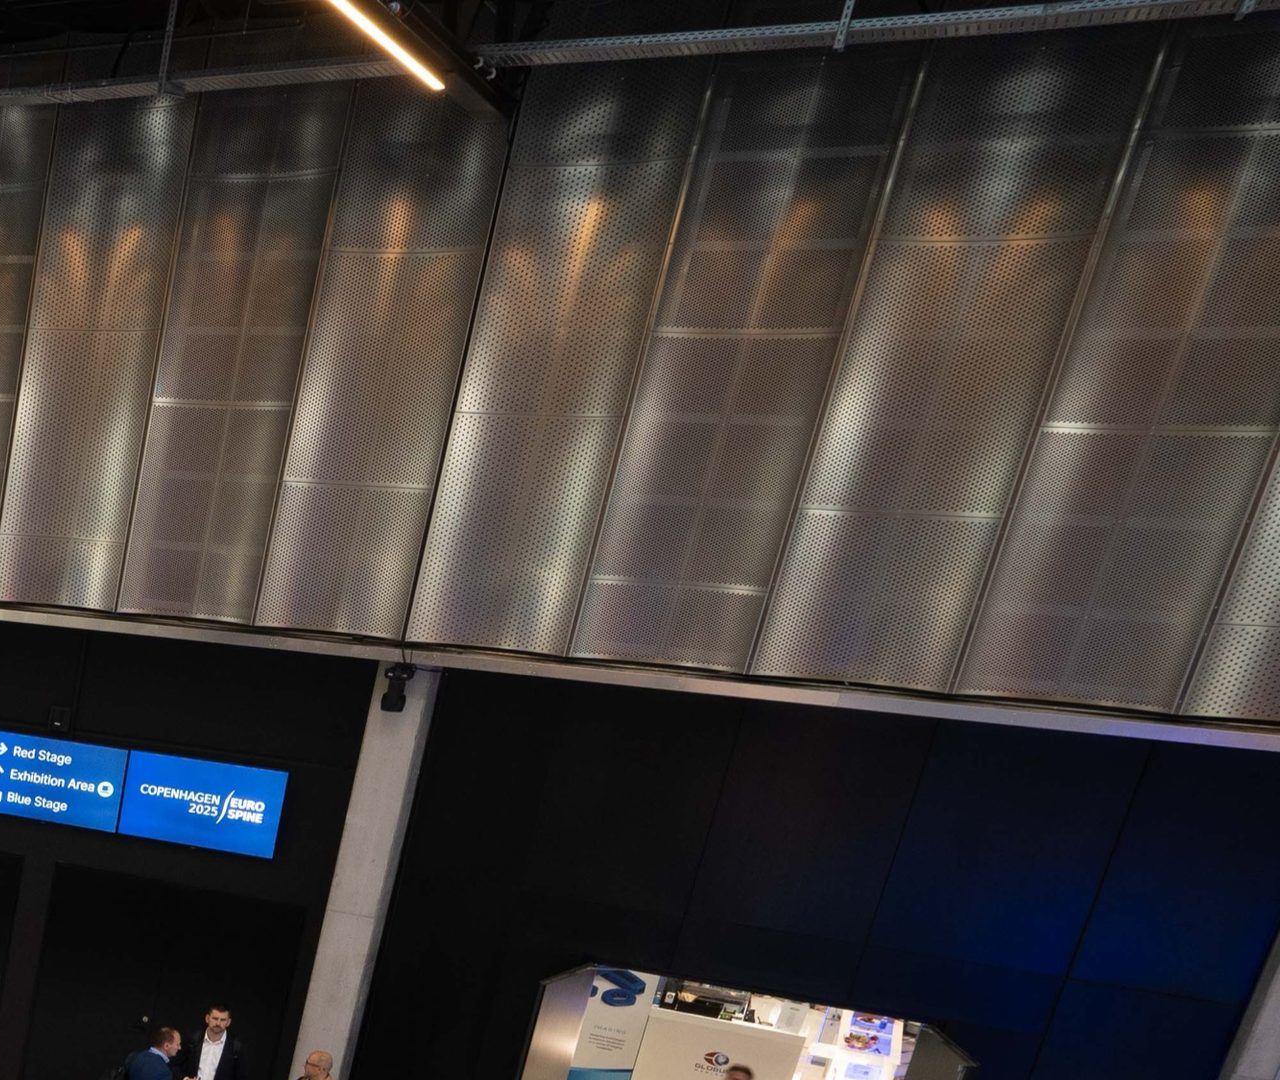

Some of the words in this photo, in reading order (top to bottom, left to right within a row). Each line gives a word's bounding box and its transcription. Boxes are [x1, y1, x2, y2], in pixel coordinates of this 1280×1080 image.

[13, 746, 35, 760] Red
[38, 750, 72, 765] Stage
[9, 768, 65, 787] Exhibition
[67, 778, 95, 793] Area
[7, 791, 32, 806] Blue
[34, 797, 68, 813] Stage
[140, 783, 220, 805] COPENHAGEN
[188, 803, 218, 817] 2025
[230, 797, 265, 812] EURO
[227, 809, 263, 824] SPINE
[694, 1063, 727, 1073] GLOBU
